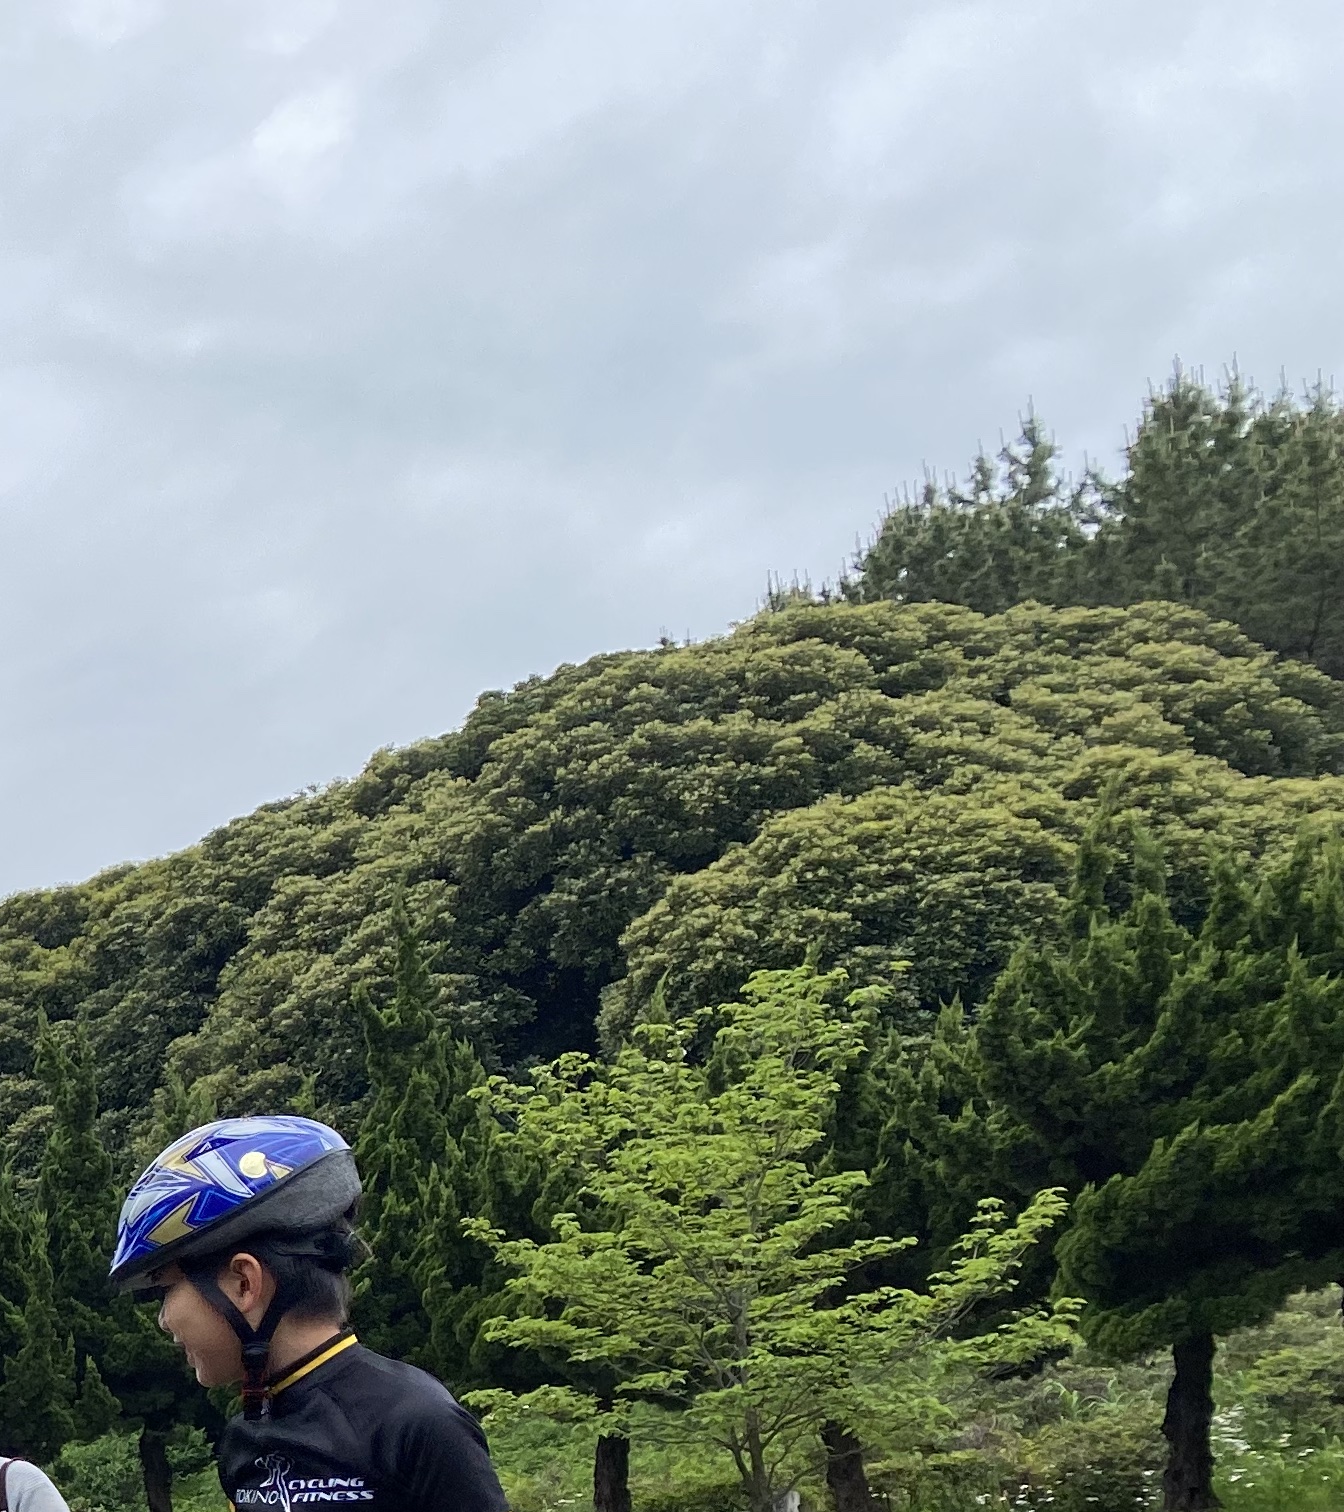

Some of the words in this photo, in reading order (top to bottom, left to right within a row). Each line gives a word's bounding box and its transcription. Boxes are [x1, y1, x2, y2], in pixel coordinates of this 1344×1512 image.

[288, 1477, 365, 1490] CYCLING
[235, 1489, 279, 1505] TOKINO
[291, 1490, 375, 1503] FITNESS
